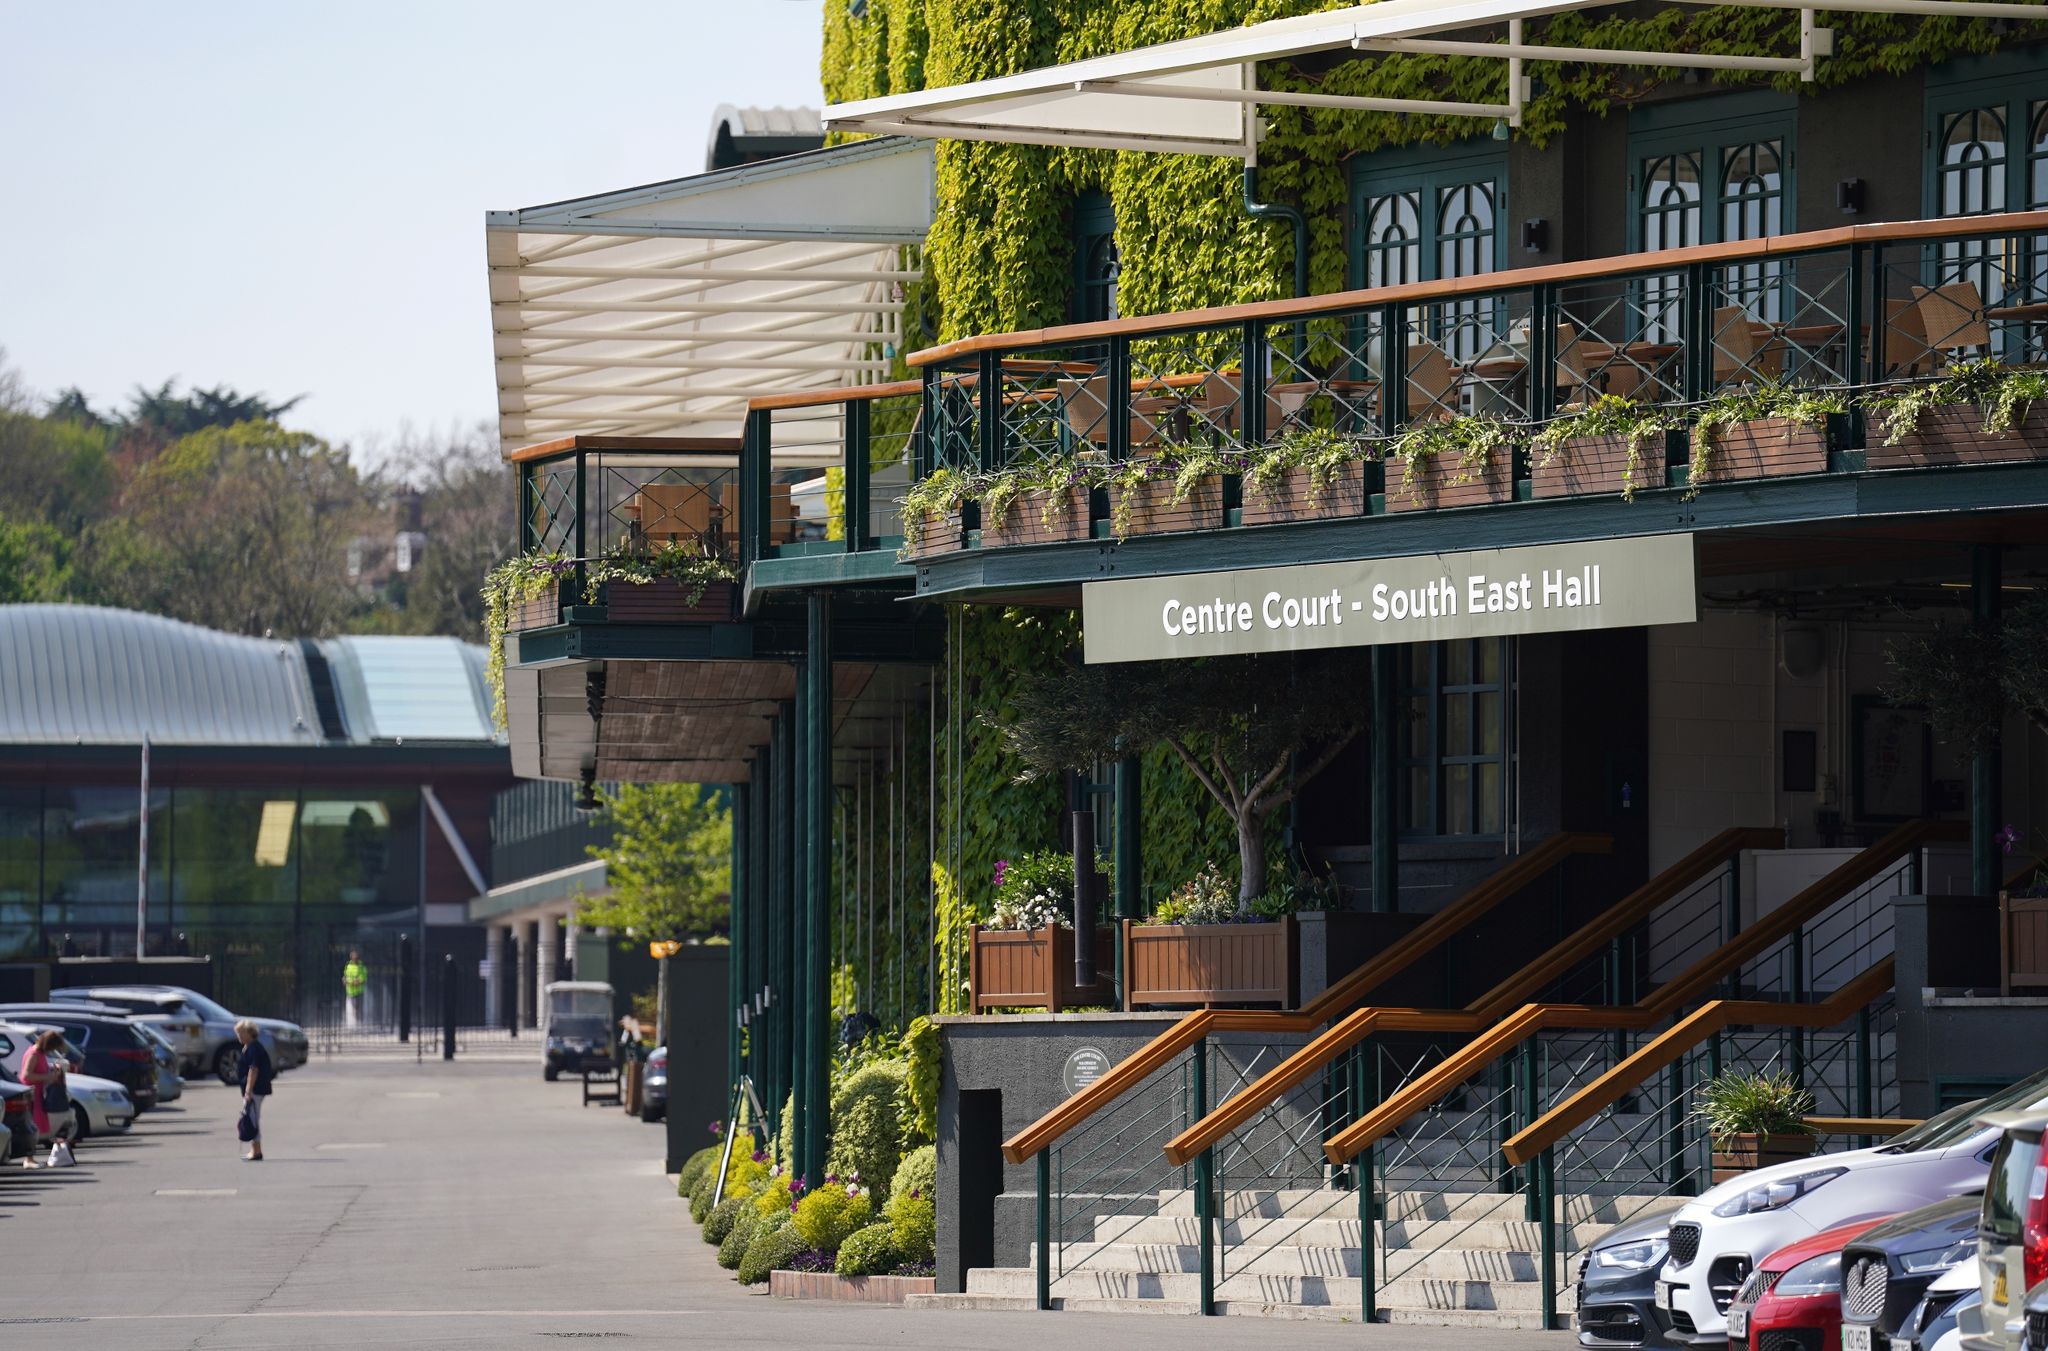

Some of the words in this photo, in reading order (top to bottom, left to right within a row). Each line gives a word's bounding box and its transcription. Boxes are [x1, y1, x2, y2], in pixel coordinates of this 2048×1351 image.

[1162, 598, 1253, 636] Centre
[1263, 588, 1342, 629] Court
[1352, 601, 1362, 611] -
[1372, 576, 1457, 621] South
[1468, 574, 1532, 614] East
[1542, 564, 1600, 608] Hall
